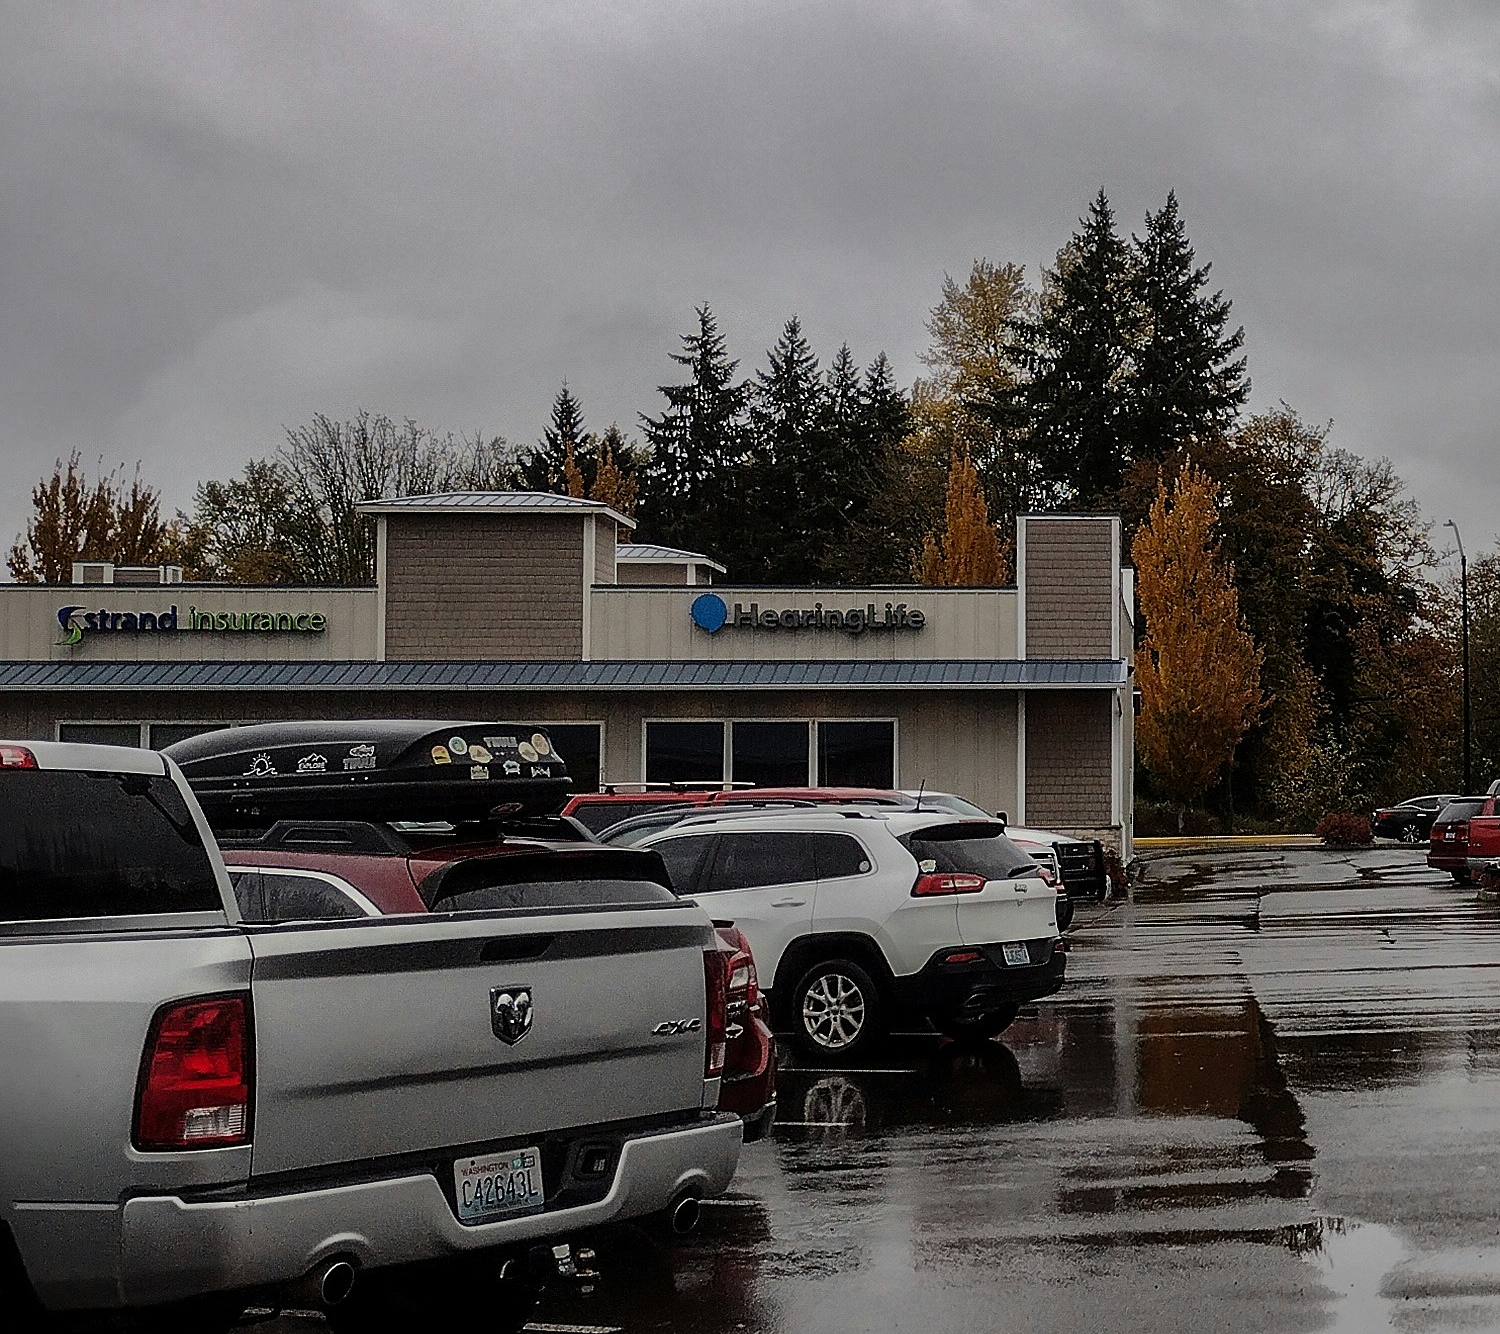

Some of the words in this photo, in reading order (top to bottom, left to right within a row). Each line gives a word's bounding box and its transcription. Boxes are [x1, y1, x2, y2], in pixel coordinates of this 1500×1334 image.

[189, 605, 326, 631] insurance
[733, 601, 926, 633] HearingLife
[461, 1161, 508, 1176] WASHINGTON
[462, 1169, 539, 1208] C42643L
